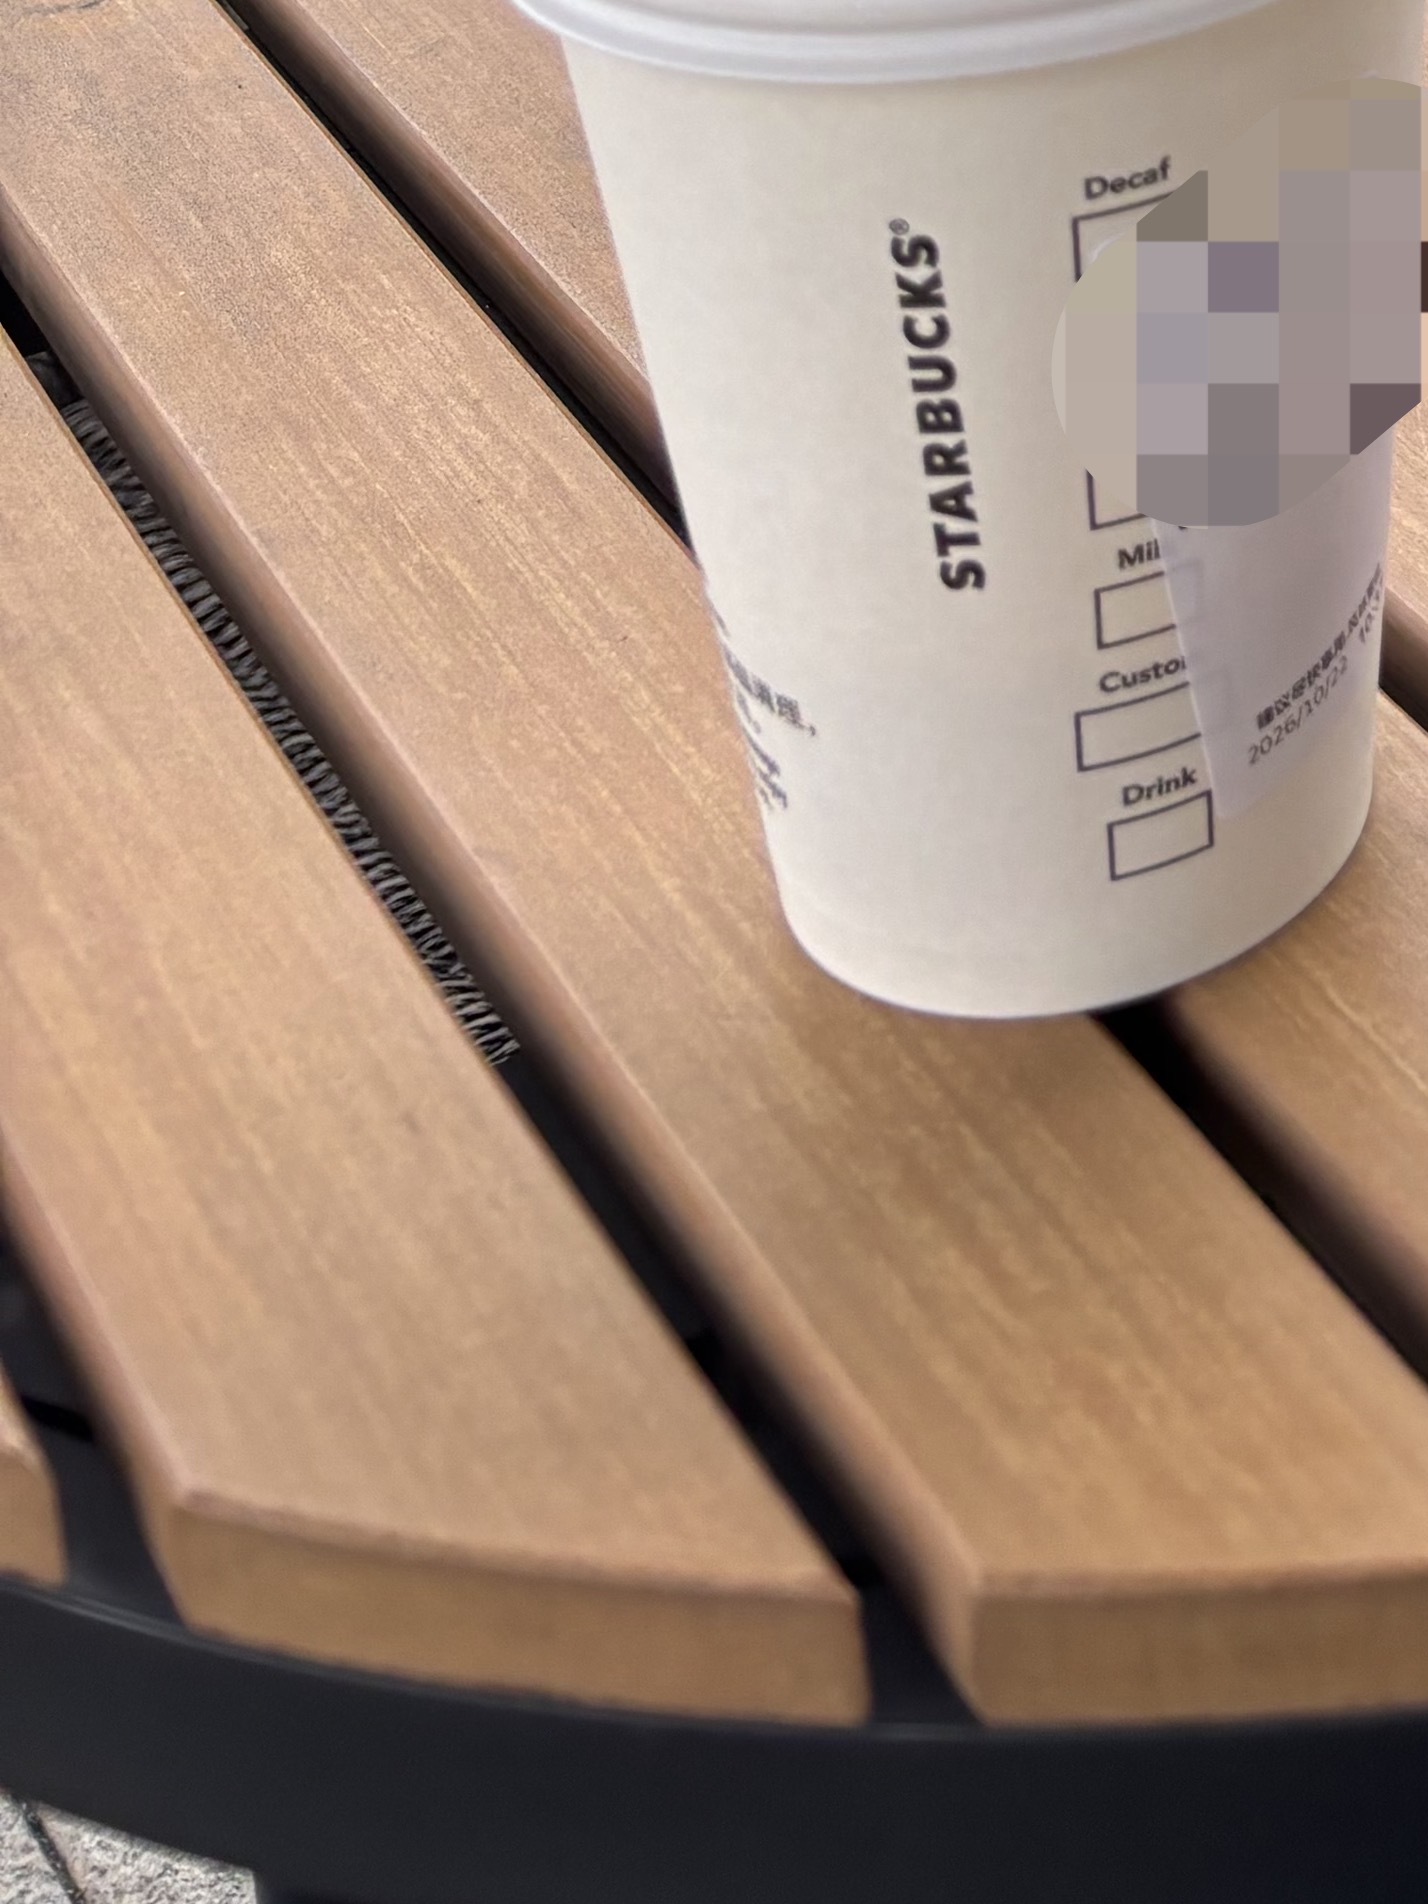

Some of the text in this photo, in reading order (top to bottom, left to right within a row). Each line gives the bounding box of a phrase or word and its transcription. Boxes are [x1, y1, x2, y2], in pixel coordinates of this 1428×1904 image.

[1083, 154, 1172, 201] Decaf
[889, 232, 987, 592] STARBUCKS
[1117, 538, 1162, 571] Mil
[1099, 655, 1187, 694] Custo
[1121, 766, 1198, 807] Drink
